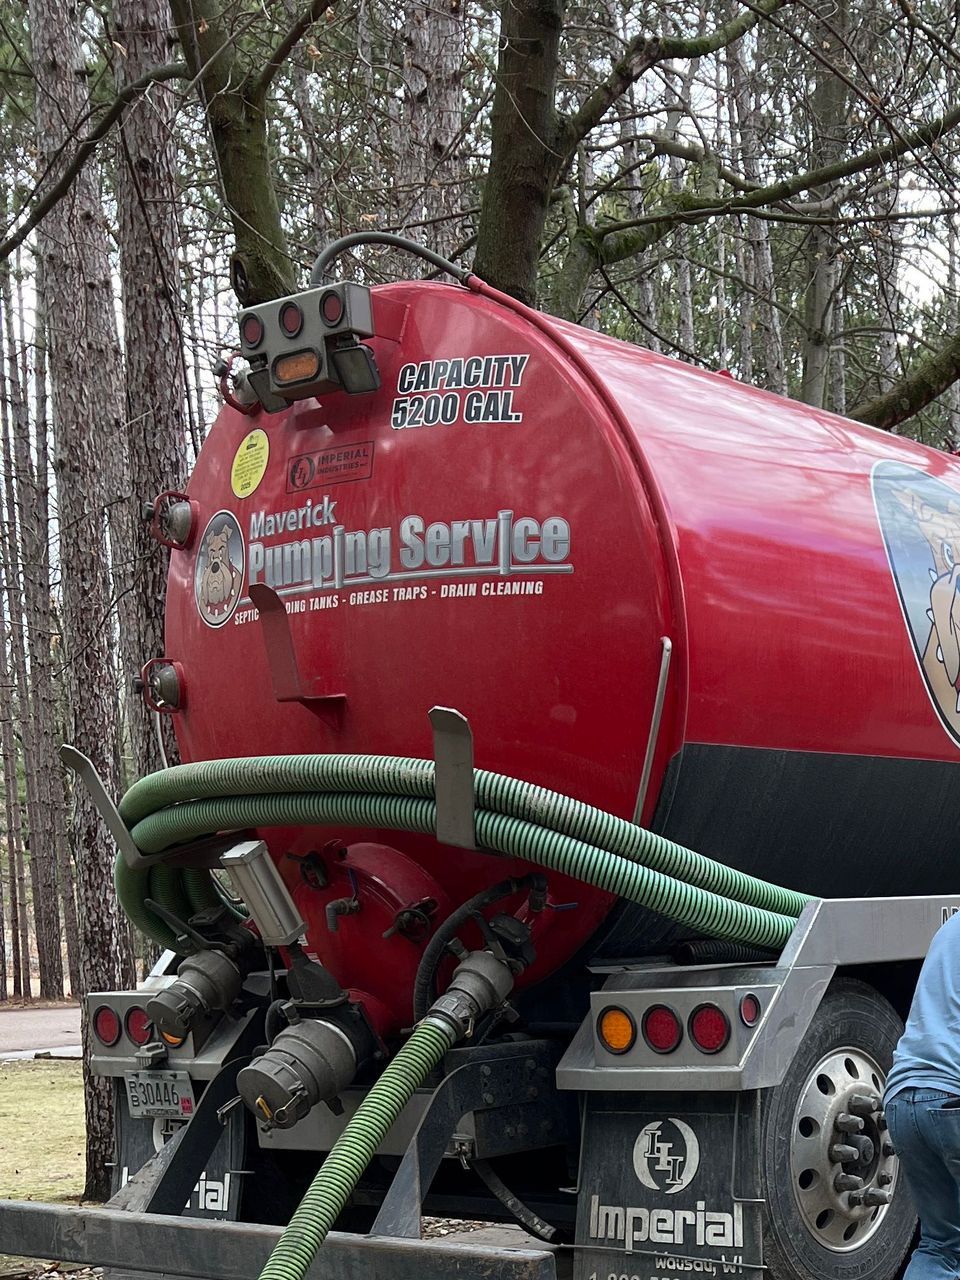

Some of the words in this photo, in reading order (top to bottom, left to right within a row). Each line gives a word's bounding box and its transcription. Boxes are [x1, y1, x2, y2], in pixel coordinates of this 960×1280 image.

[397, 354, 530, 394] CAPACITY
[391, 392, 460, 429] 5200
[463, 390, 523, 423] GAL.
[317, 447, 368, 466] IMPERIAL
[317, 461, 361, 475] INDUSTRIES
[250, 495, 338, 539] Maverick
[248, 525, 392, 589] Pumping
[400, 509, 570, 576] Service
[234, 608, 260, 625] SEPTIC
[285, 601, 306, 615] DING
[309, 595, 339, 611] TANKS
[349, 589, 389, 606] GREASE
[393, 586, 428, 601] TRAPS
[440, 583, 477, 598] DRAIN
[481, 581, 544, 596] CLEANING
[138, 1082, 180, 1106] 30446
[590, 1195, 744, 1254] Imperial
[654, 1251, 717, 1277] Wausau,
[721, 1254, 743, 1274] WI
